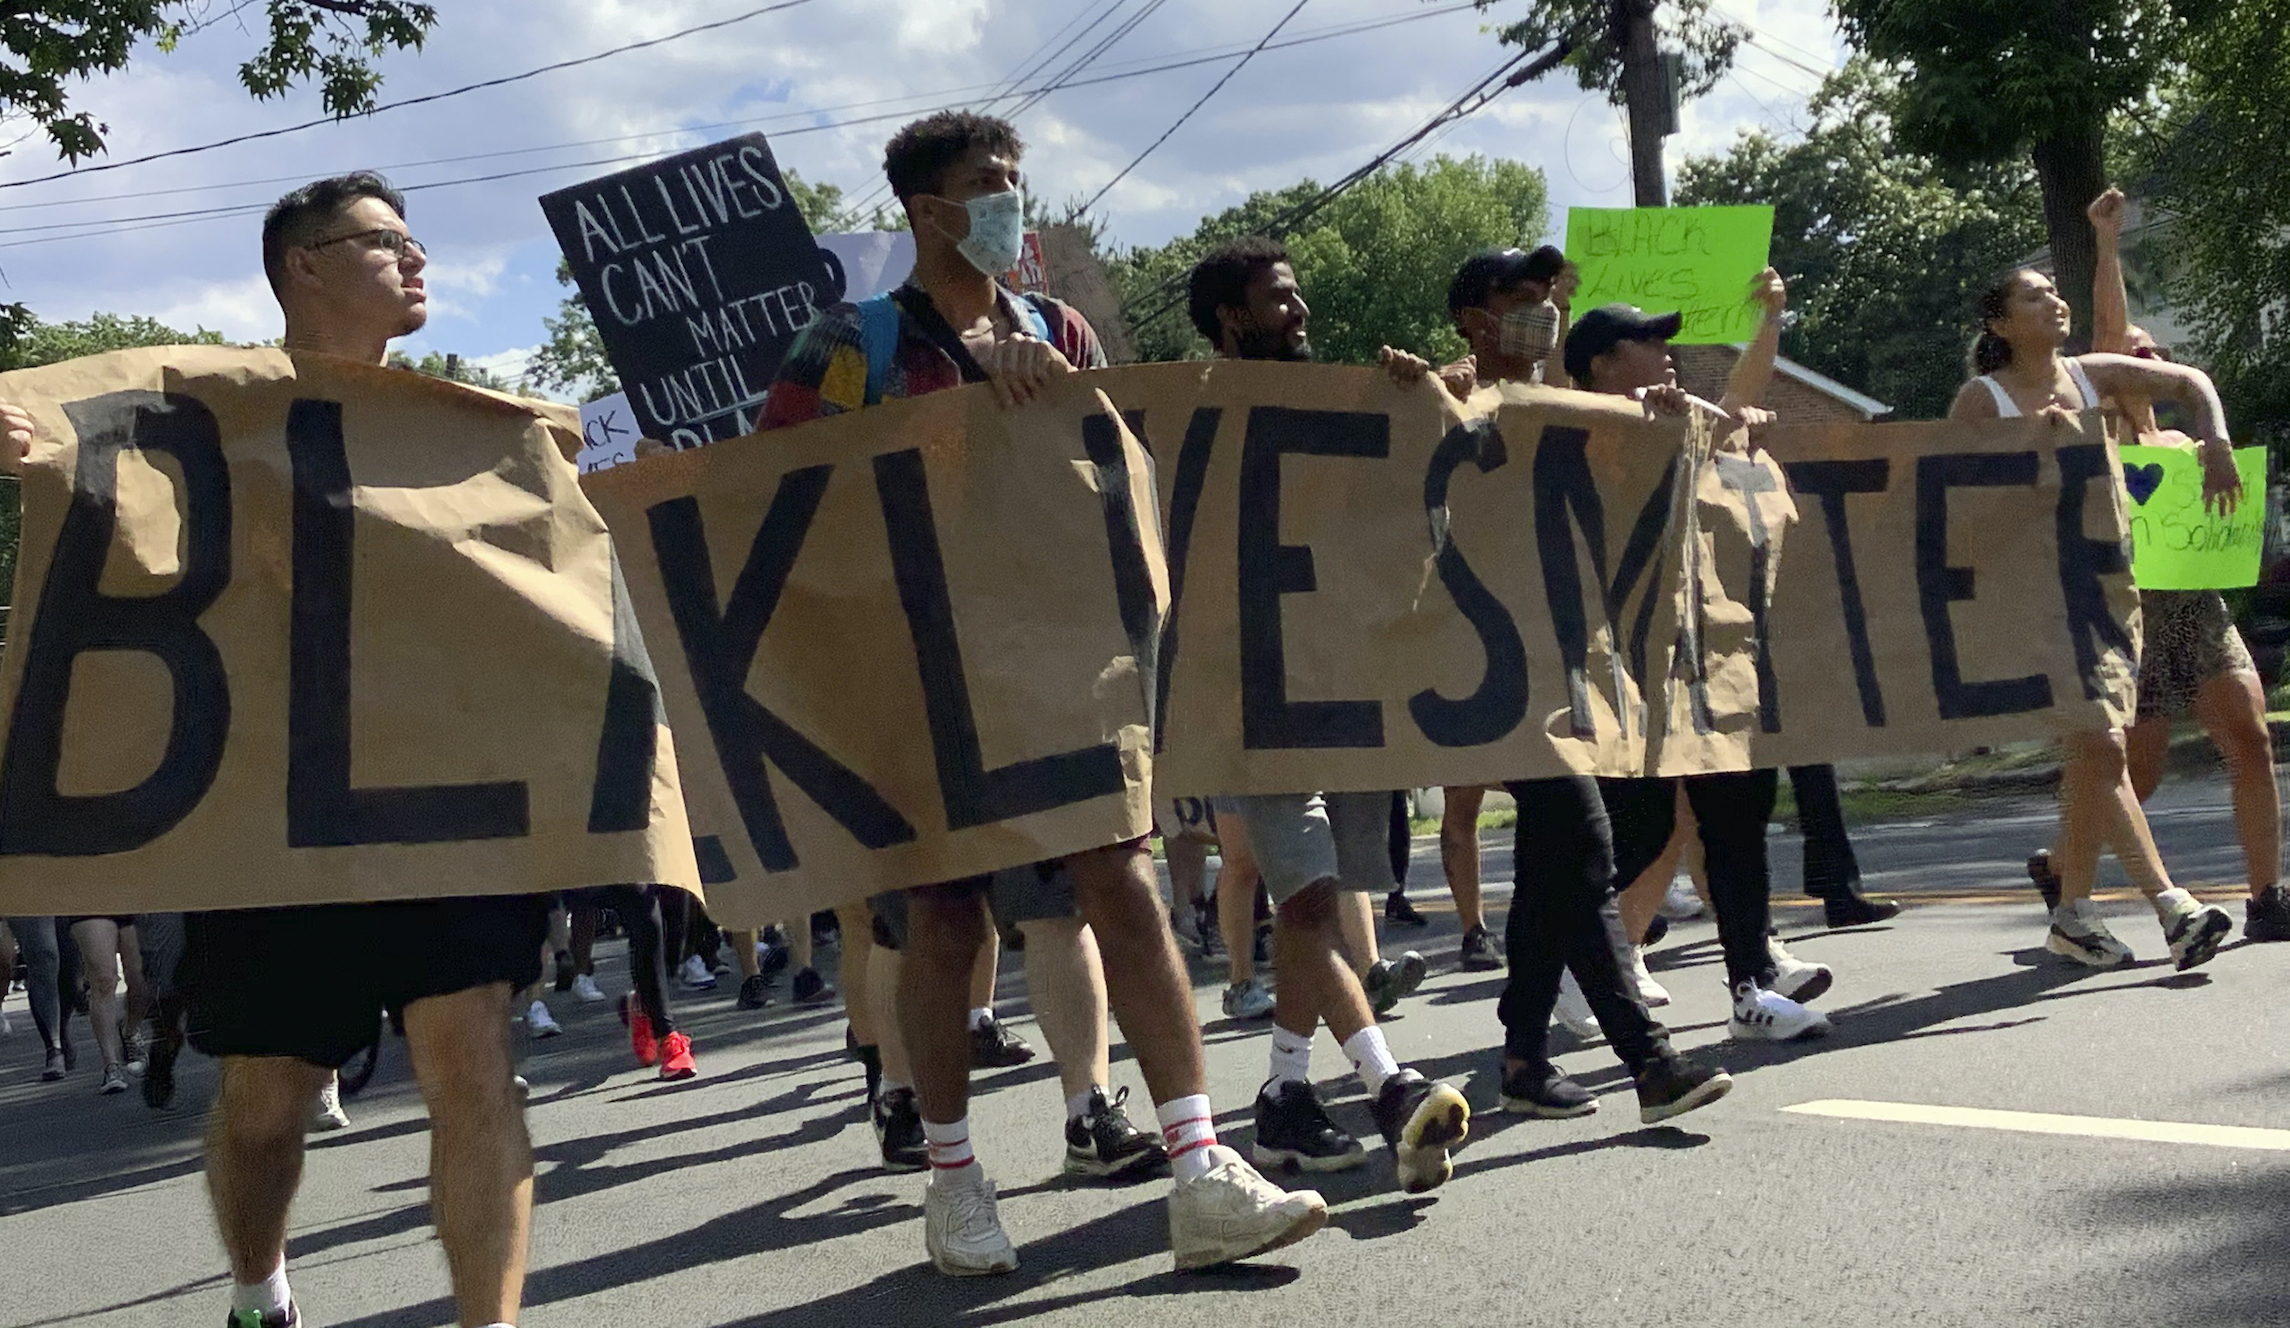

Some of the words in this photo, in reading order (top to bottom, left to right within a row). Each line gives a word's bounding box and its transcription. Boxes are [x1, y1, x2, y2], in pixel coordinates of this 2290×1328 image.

[575, 185, 666, 263] ALL
[654, 145, 783, 236] LIVES
[601, 234, 724, 326] CAN'T
[686, 281, 819, 358] MATTER
[640, 354, 768, 427] UNTIL
